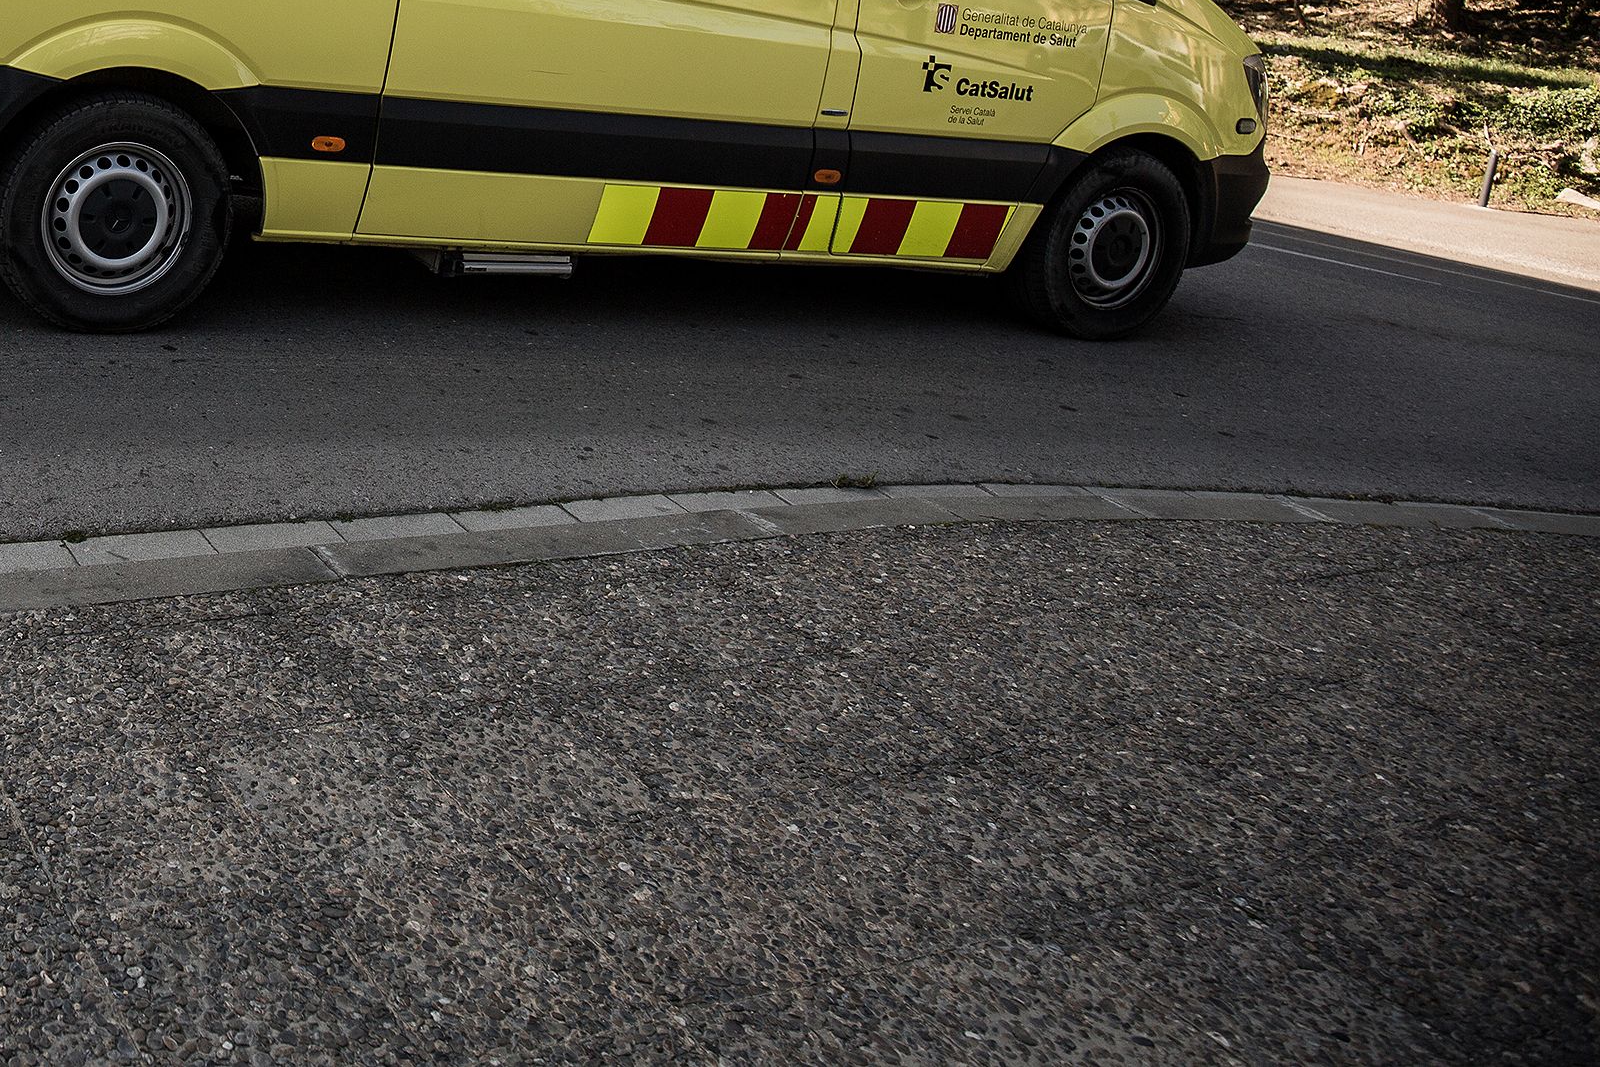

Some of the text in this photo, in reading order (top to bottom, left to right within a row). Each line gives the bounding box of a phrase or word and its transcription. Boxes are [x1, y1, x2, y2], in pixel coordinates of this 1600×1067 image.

[962, 8, 1088, 35] Generalitat de Catalunya
[960, 24, 1077, 48] Departament de Salut
[956, 78, 1034, 102] CatSalut
[948, 115, 984, 126] de la Salut
[950, 105, 996, 117] Servei Català
